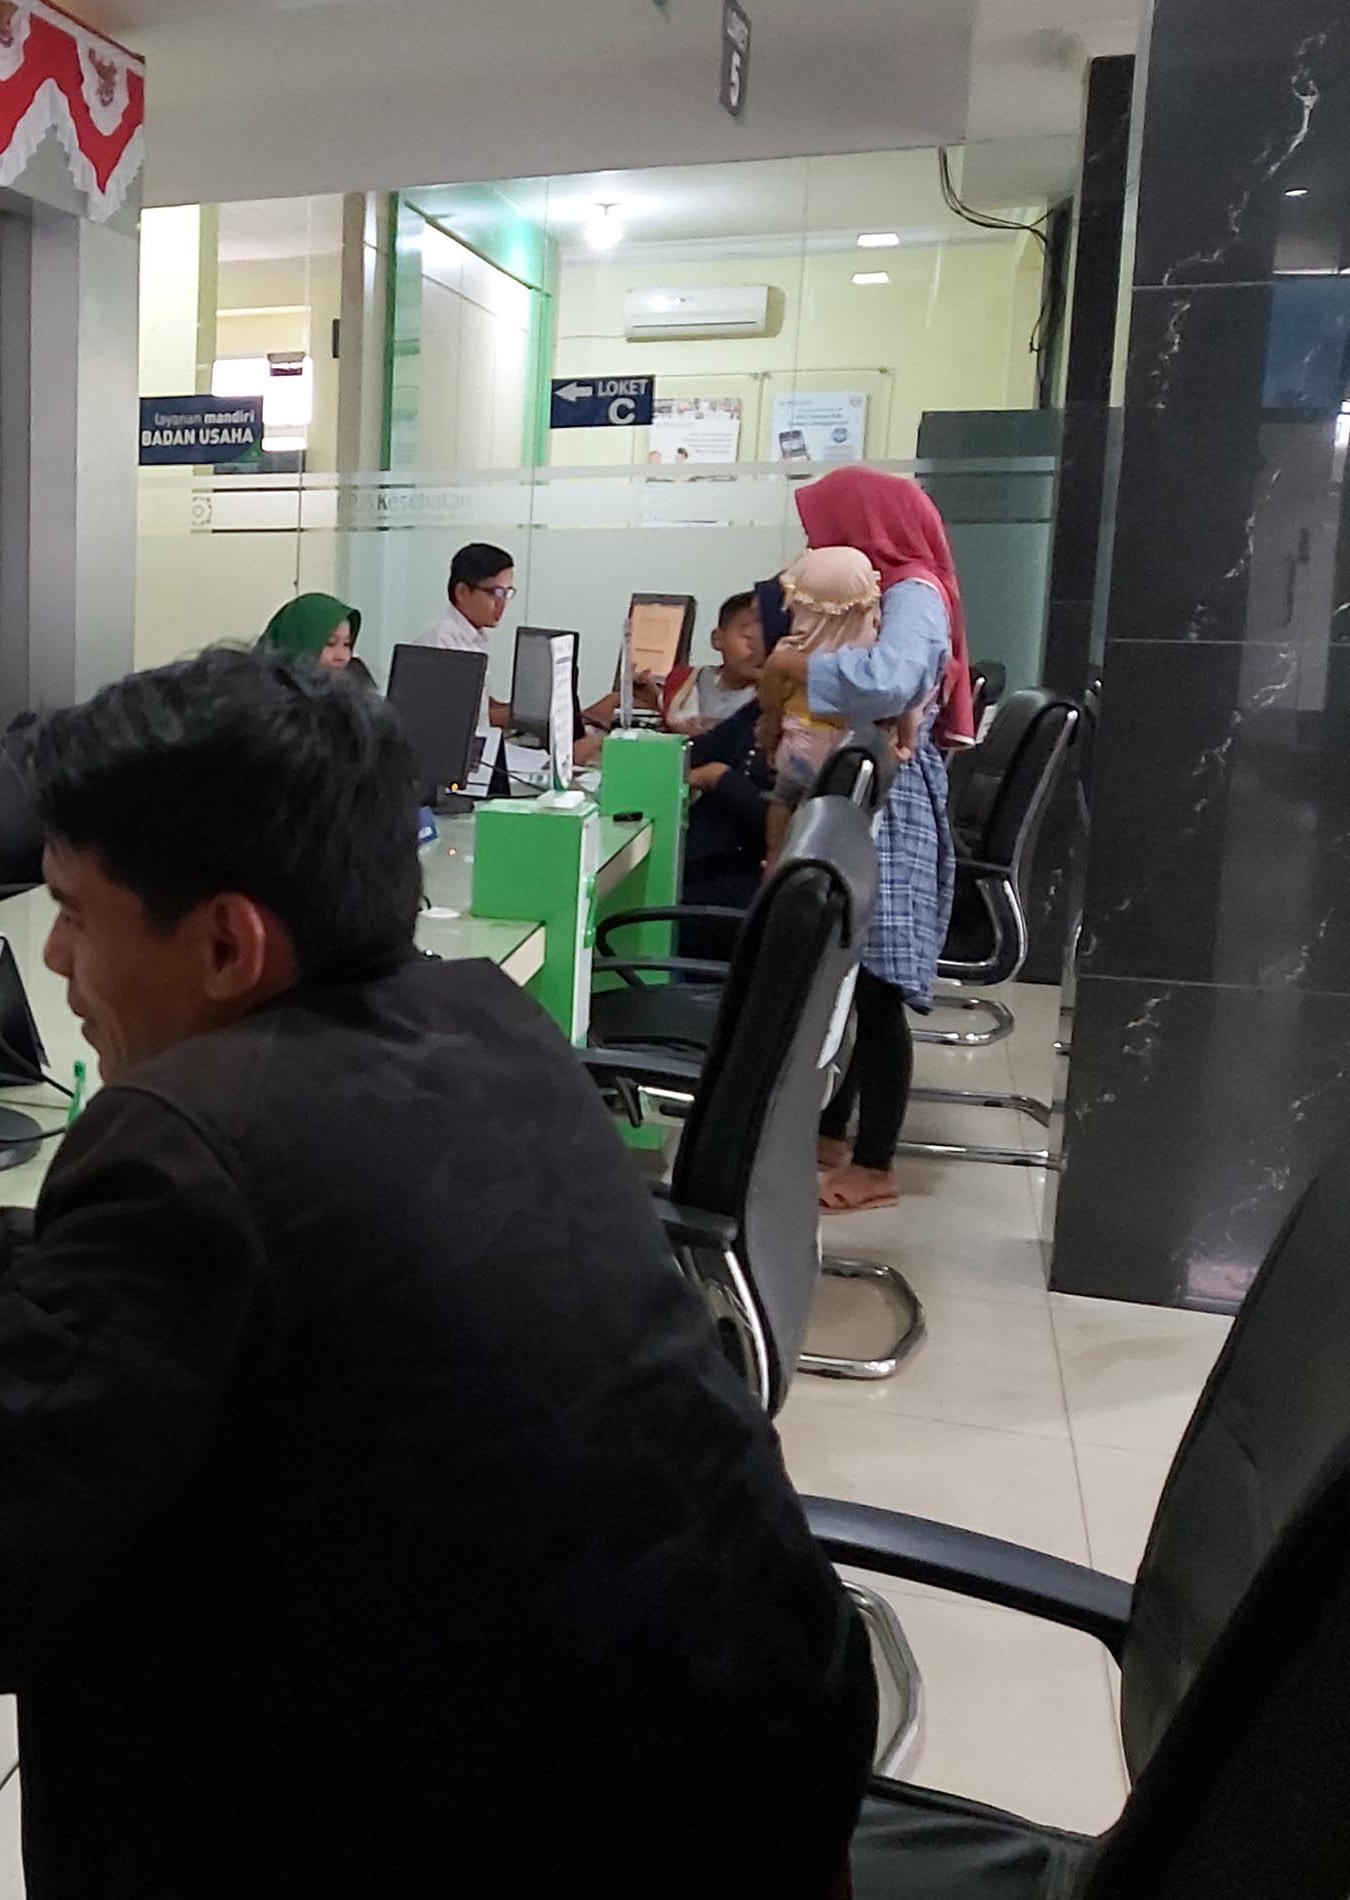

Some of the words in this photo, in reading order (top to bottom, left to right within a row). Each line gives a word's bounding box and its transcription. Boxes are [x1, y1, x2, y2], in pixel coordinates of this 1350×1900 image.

[599, 379, 649, 398] LOKET
[204, 409, 254, 425] mandiri
[608, 398, 636, 425] C
[142, 429, 195, 447] BADAN
[199, 428, 254, 445] USAHA
